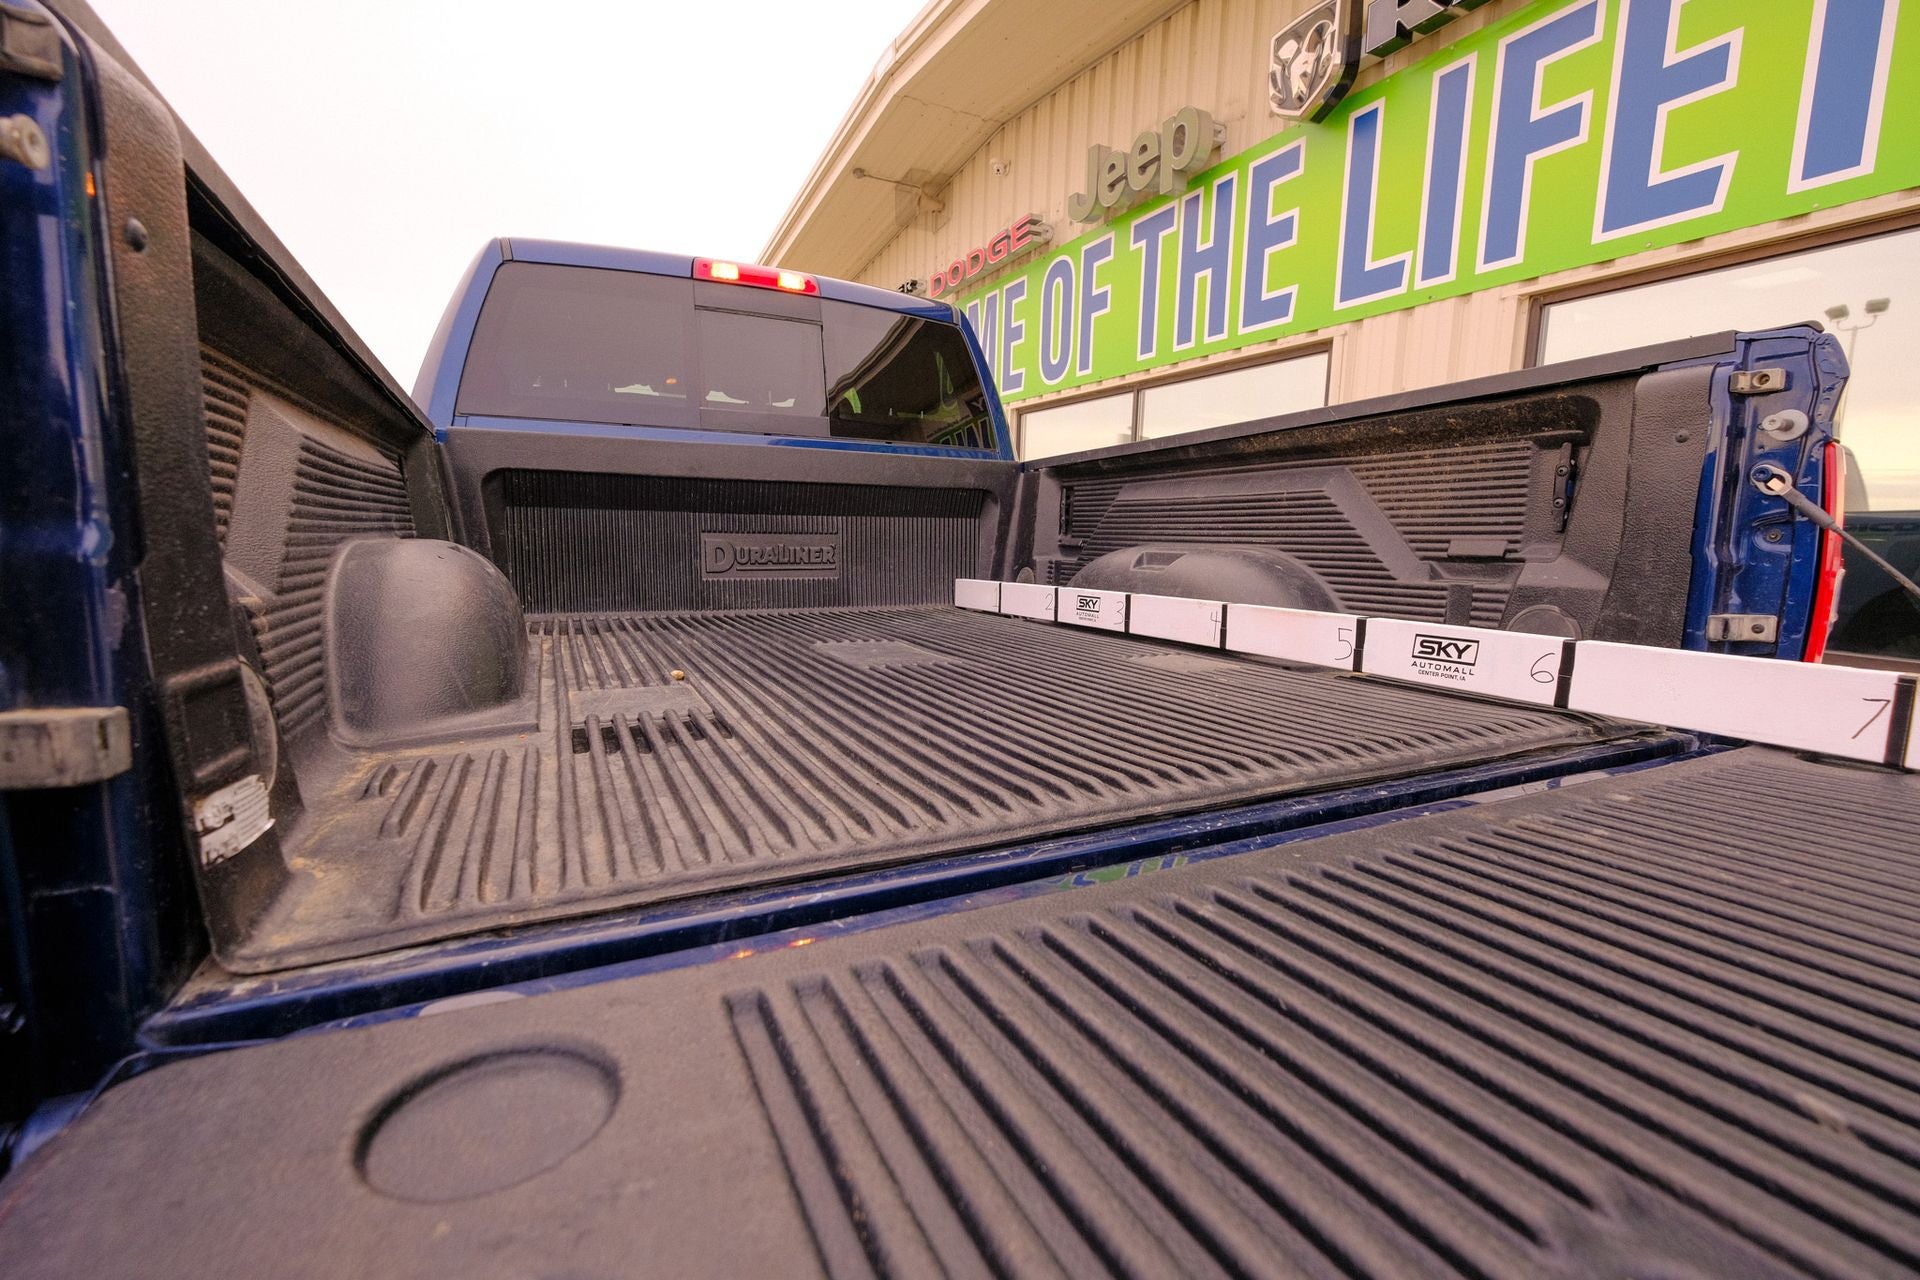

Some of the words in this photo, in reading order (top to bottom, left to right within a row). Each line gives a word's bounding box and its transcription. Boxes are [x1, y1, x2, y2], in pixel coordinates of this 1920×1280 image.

[1068, 105, 1208, 221] Jeep
[930, 213, 1036, 298] DODGE
[1039, 231, 1115, 385] OF
[1131, 136, 1306, 361] THE
[1045, 593, 1054, 610] 2
[1079, 598, 1098, 609] SKY
[1113, 601, 1124, 625] 3
[1210, 611, 1220, 641] 4
[1335, 627, 1353, 660] 5
[1418, 639, 1472, 659] SKY
[1411, 660, 1475, 676] AUTOMALL
[1418, 669, 1440, 677] CENTER
[1440, 672, 1459, 681] POINT,
[1531, 652, 1555, 683] 6
[1851, 698, 1892, 740] 7
